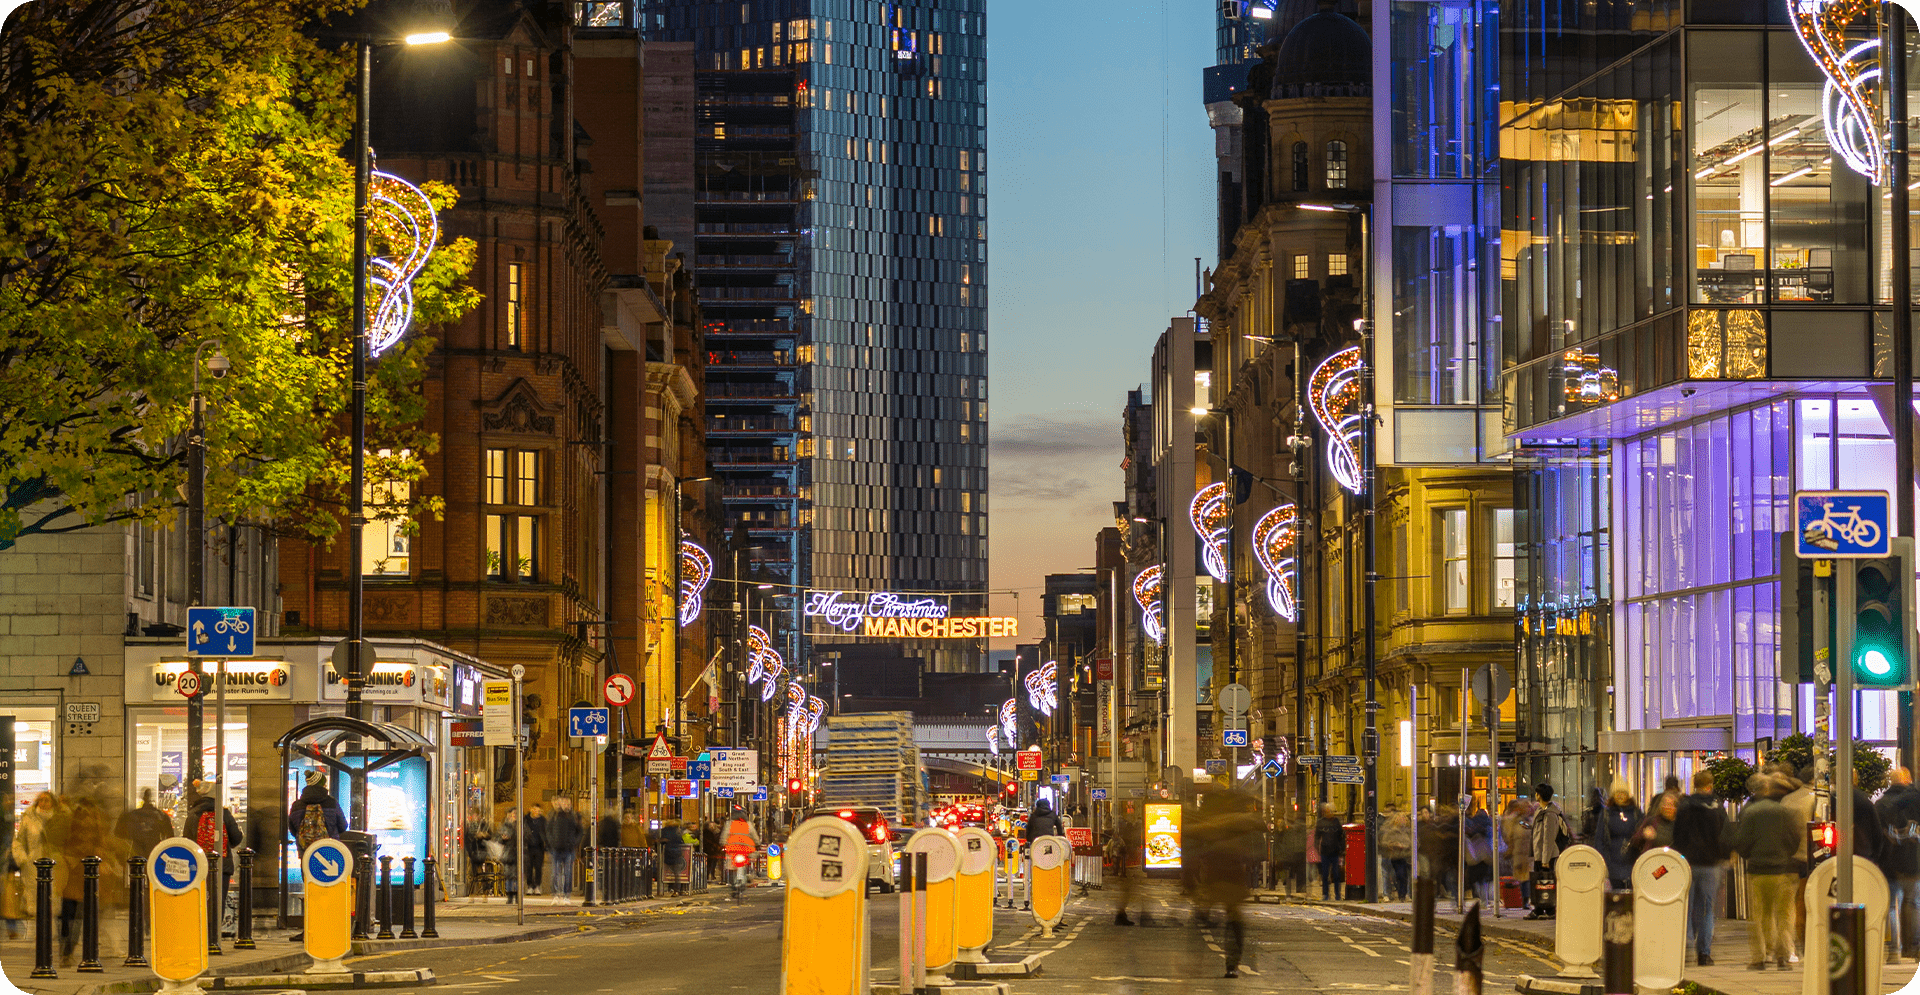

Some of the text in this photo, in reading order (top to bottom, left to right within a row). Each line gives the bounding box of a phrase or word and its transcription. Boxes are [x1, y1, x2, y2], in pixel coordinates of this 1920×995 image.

[805, 592, 948, 631] Merry Christmas
[865, 617, 1018, 637] MANCHESTER
[155, 672, 176, 686] UP
[181, 678, 196, 689] 20
[68, 705, 97, 713] QUEEN
